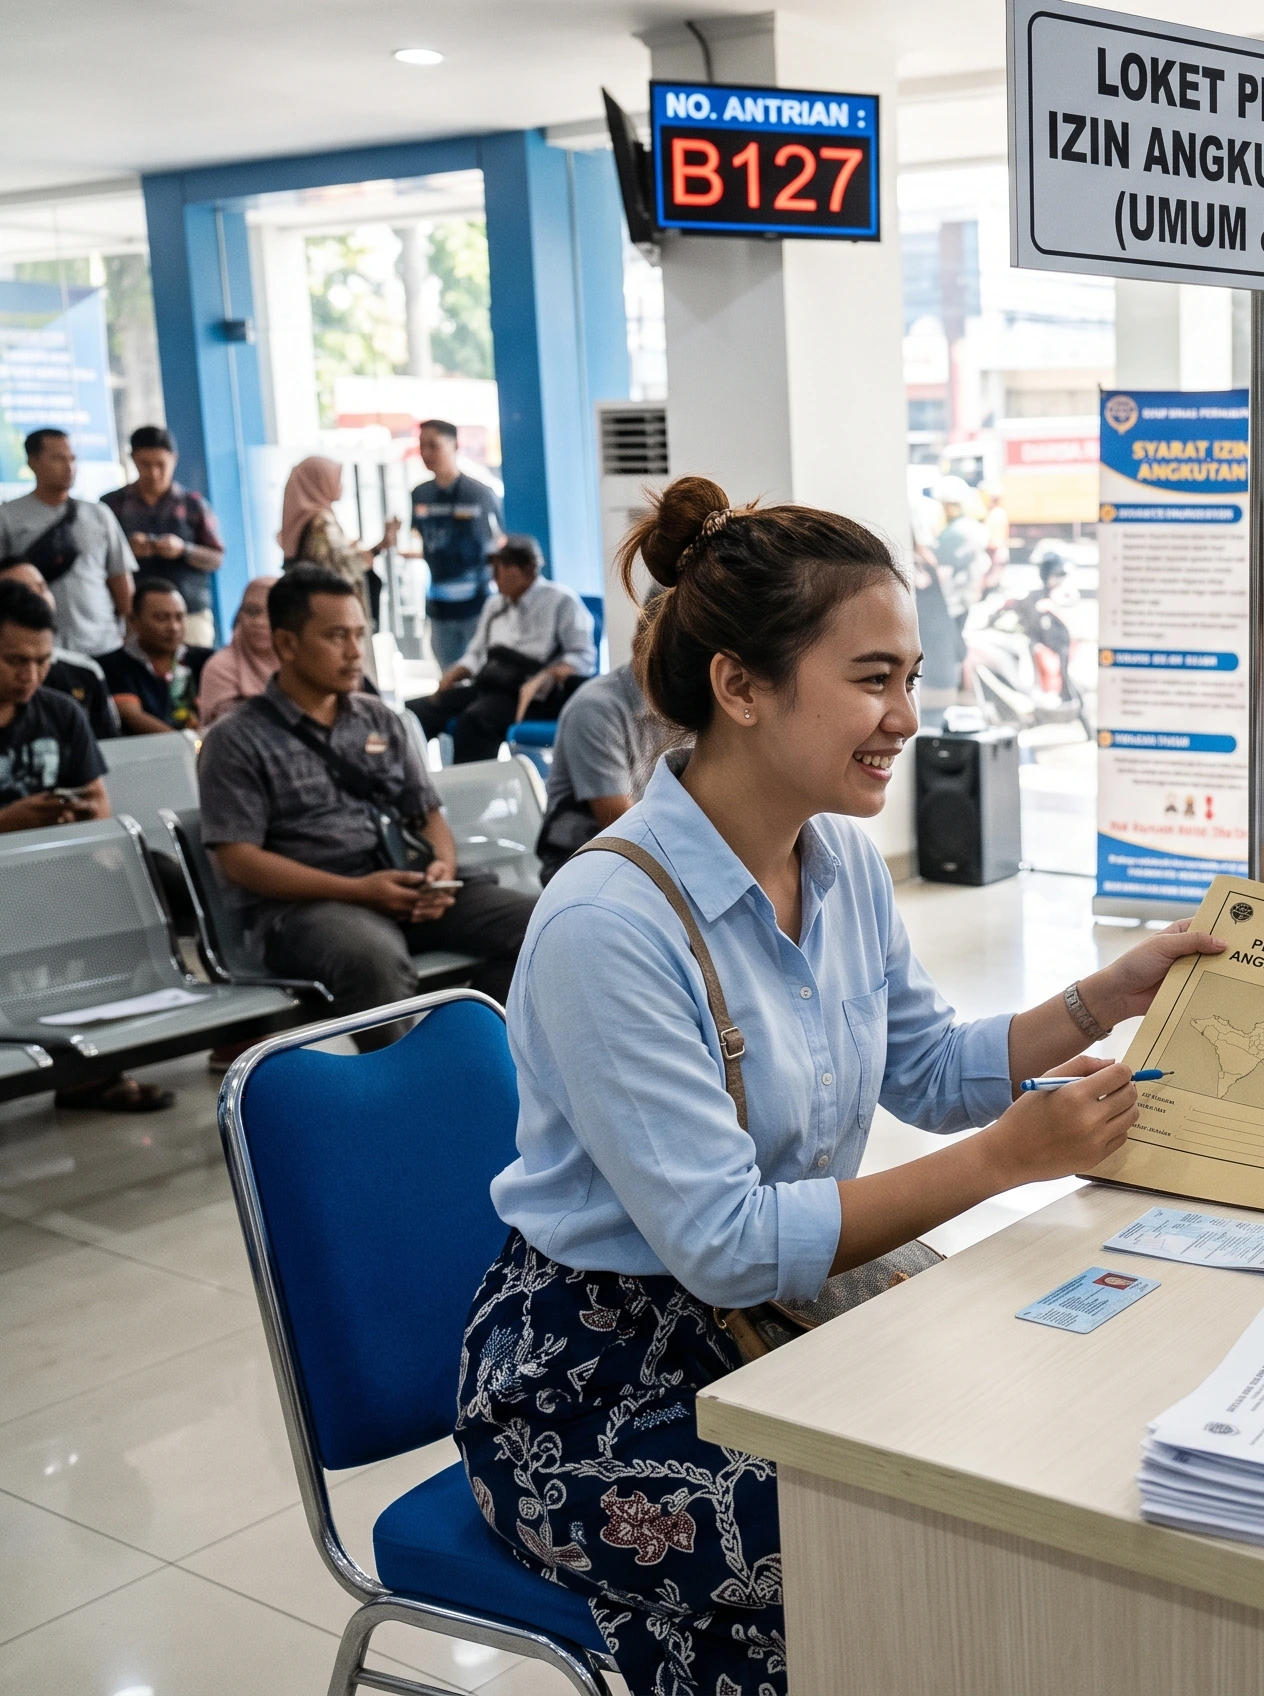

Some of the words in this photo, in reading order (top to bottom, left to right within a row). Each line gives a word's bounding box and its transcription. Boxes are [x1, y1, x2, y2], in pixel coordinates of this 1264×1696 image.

[1097, 47, 1225, 113] LOKET
[666, 92, 717, 121] NO.
[723, 96, 849, 128] ANTRIAN
[1048, 111, 1130, 169] IZIN
[671, 137, 863, 213] B127
[1114, 191, 1247, 252] (UMUM
[1132, 440, 1209, 460] SYARAT
[1137, 463, 1247, 481] ANGKUTAN
